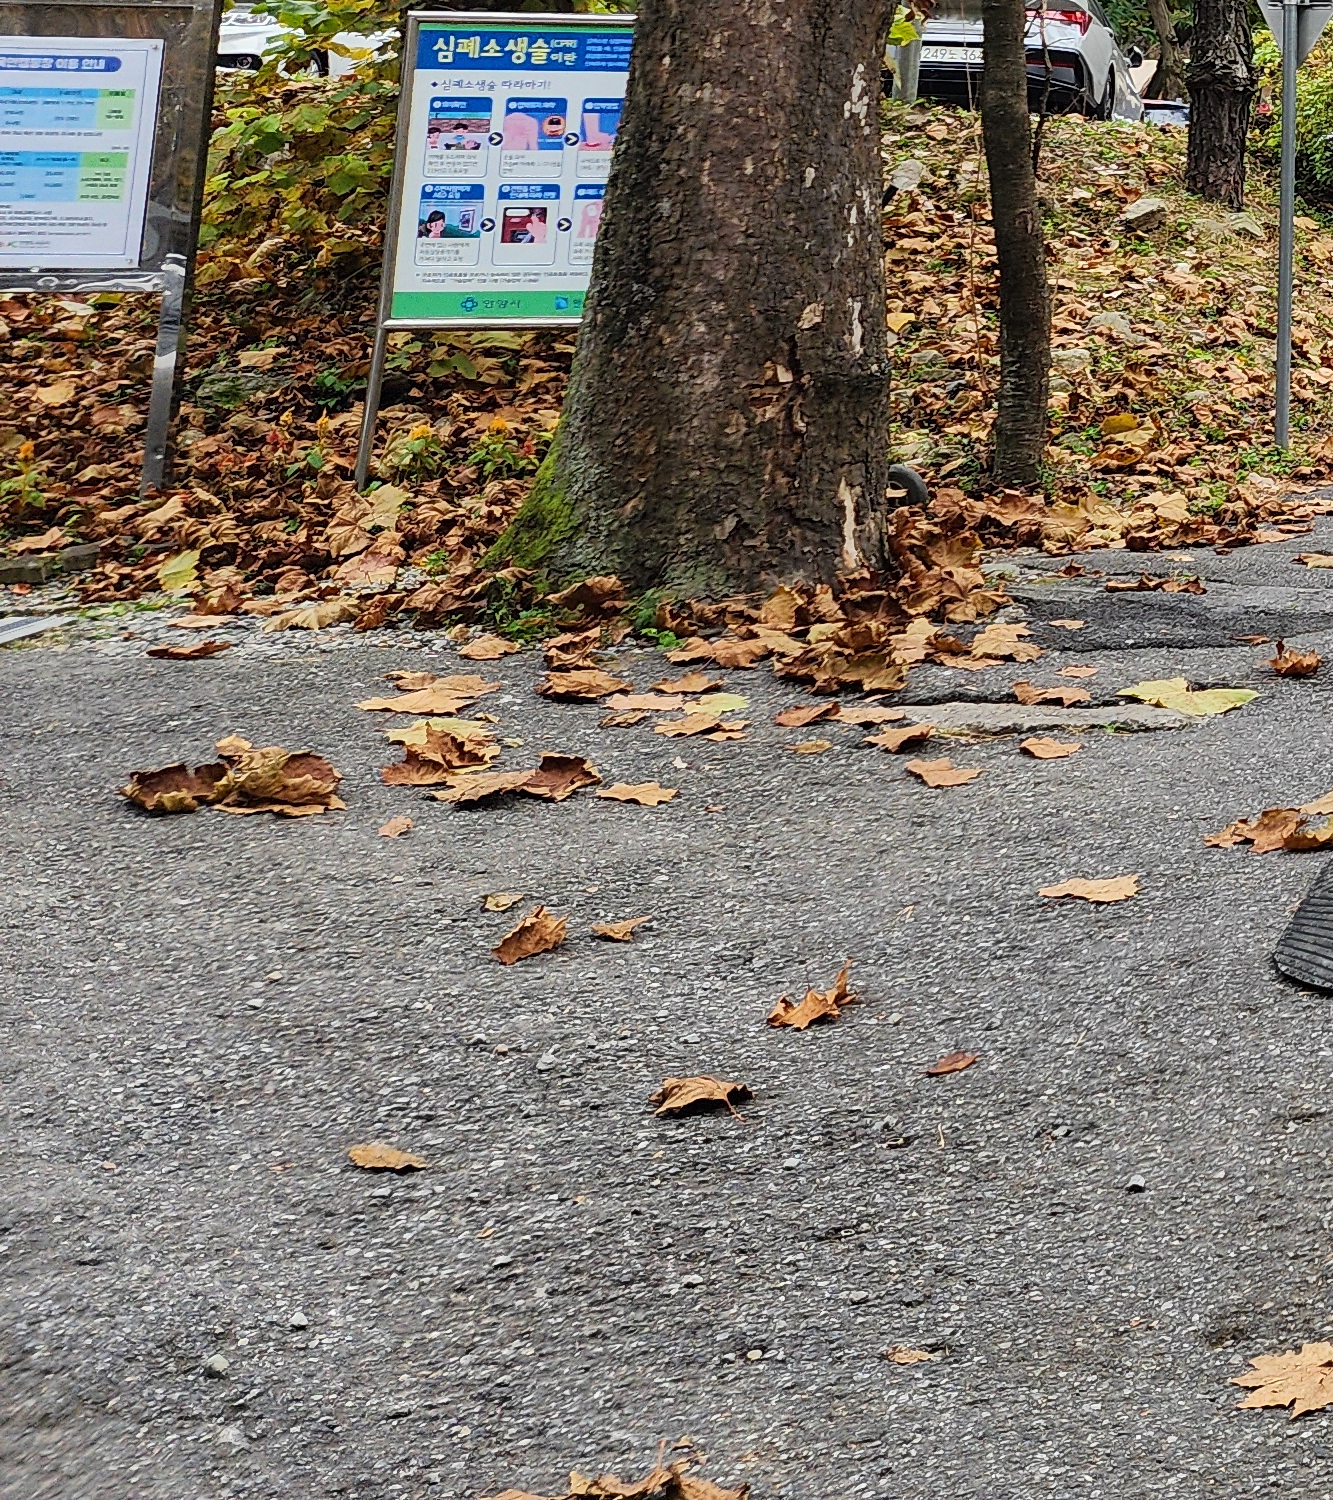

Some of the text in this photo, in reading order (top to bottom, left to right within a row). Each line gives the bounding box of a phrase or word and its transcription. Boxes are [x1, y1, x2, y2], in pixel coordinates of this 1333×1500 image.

[431, 34, 552, 65] 심폐소생술
[922, 47, 958, 60] 249노
[55, 58, 79, 69] 이용
[81, 58, 106, 70] 안내
[550, 52, 578, 66] 이란
[440, 78, 551, 92] 심폐소생술 따라하기!
